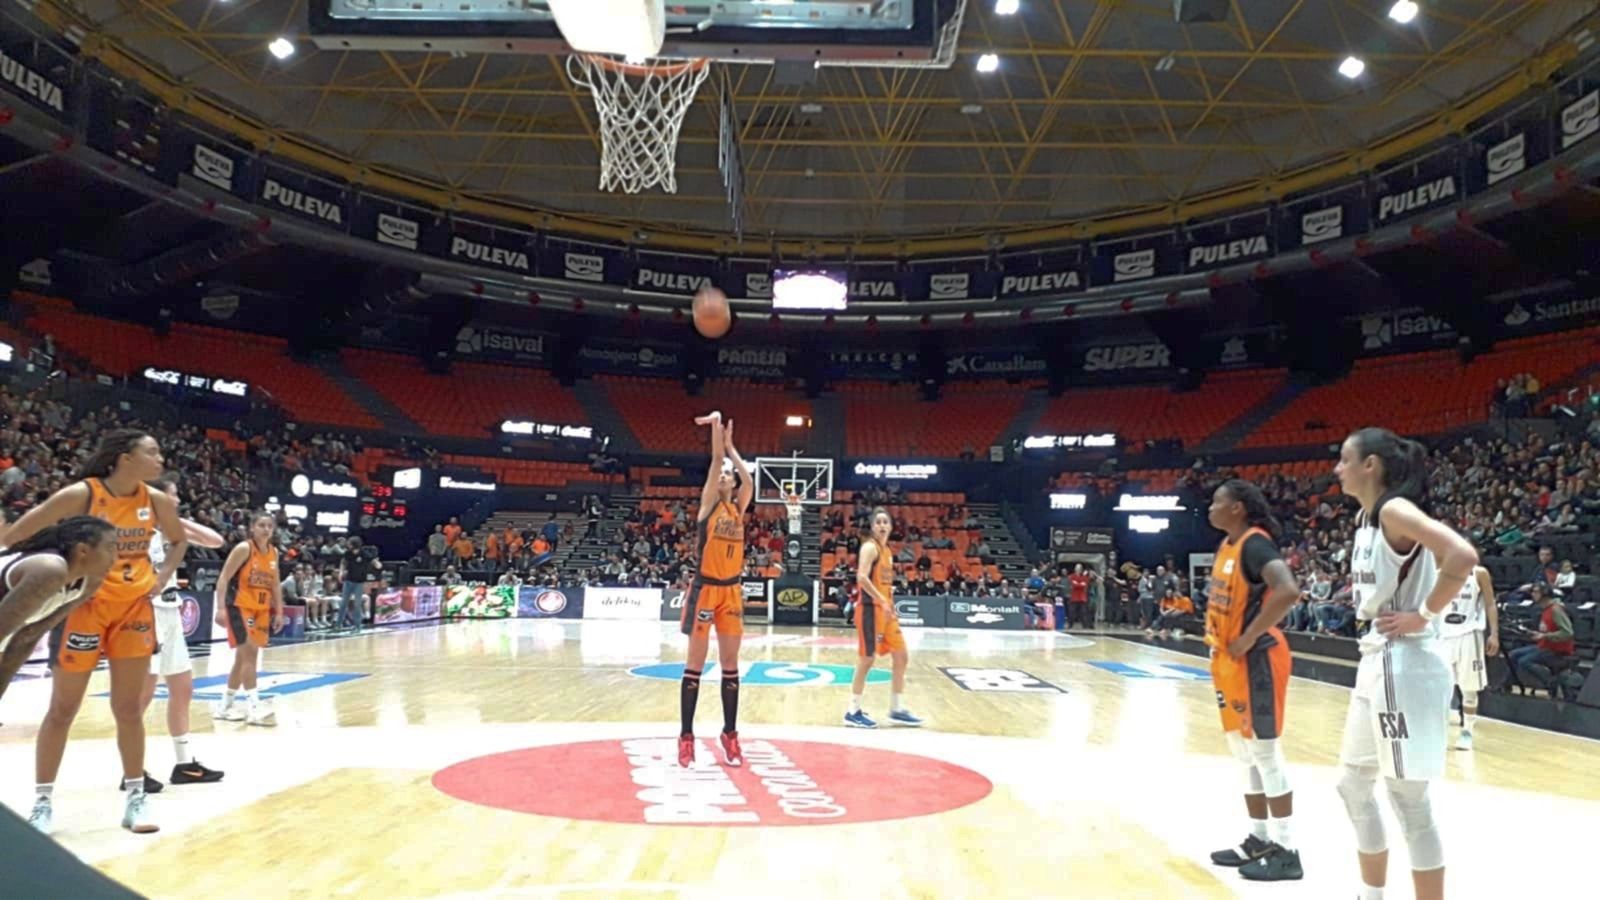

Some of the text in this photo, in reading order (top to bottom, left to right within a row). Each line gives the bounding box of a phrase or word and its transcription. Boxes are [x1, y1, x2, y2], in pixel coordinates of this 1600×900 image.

[0, 50, 63, 111] ULEVA
[263, 179, 341, 224] PULEVA
[1379, 176, 1456, 220] PULEVA
[452, 236, 529, 270] PULEVA
[1189, 235, 1268, 267] PULEVA
[638, 268, 713, 291] PULEVA
[850, 281, 896, 297] LEVA
[1002, 271, 1080, 294] PULEVA
[1082, 344, 1172, 372] SUPER
[726, 543, 735, 560] 11
[122, 563, 134, 582] 2
[1378, 711, 1409, 739] FSA
